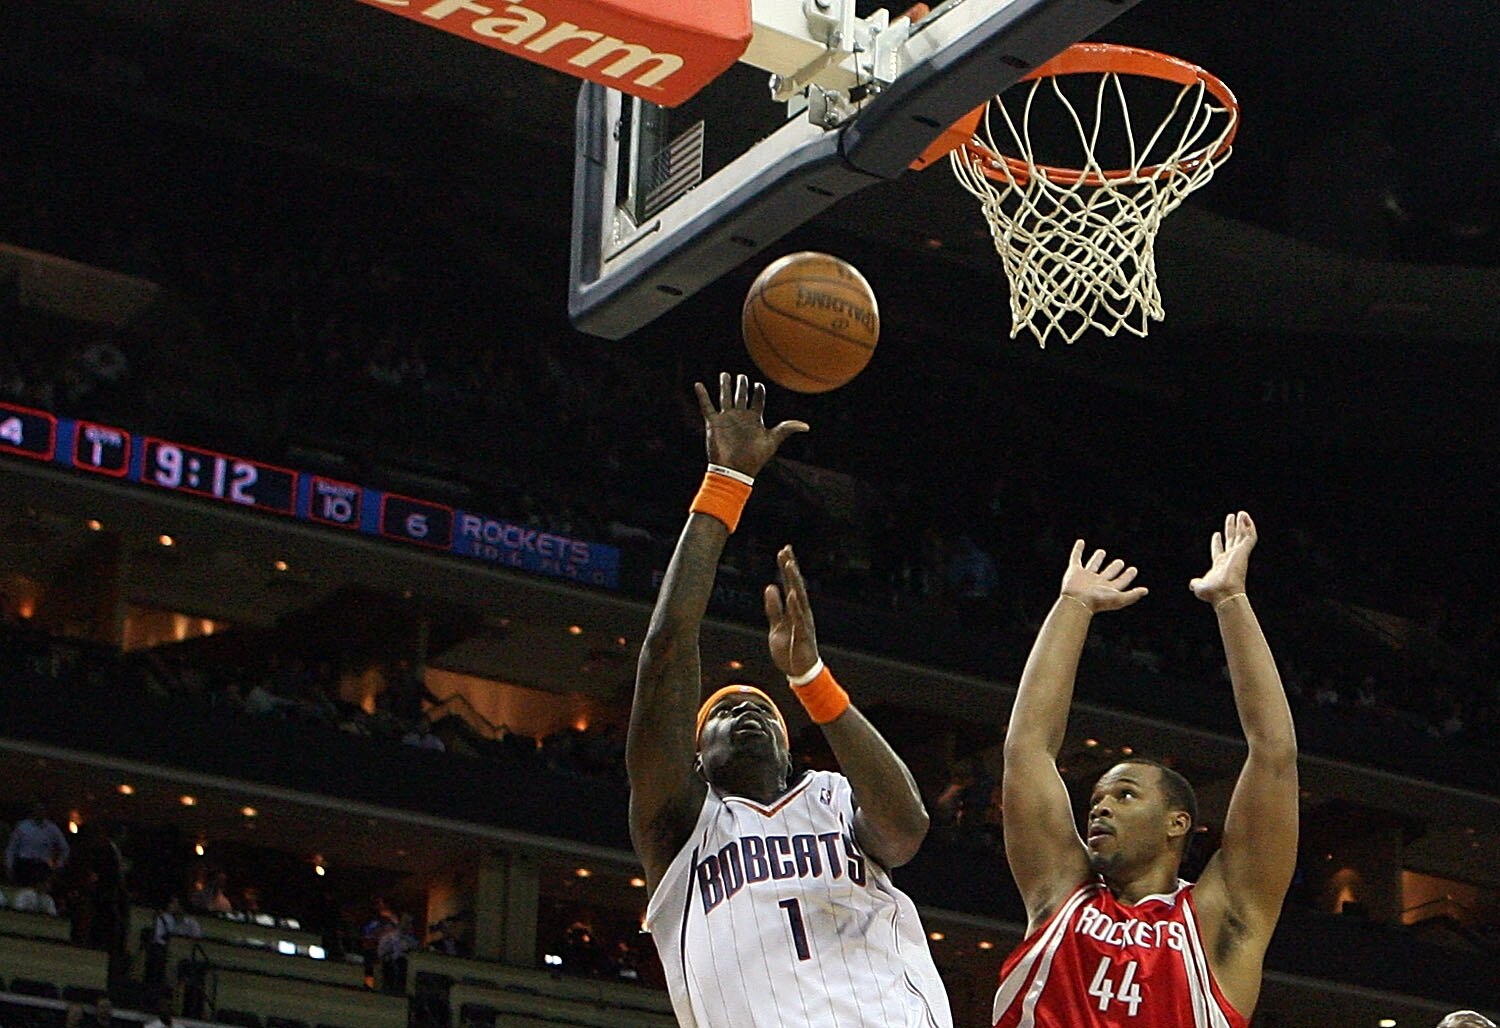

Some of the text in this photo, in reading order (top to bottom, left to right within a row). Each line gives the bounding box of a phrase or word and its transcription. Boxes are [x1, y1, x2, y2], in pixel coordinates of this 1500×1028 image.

[420, 0, 684, 87] Farm
[155, 444, 258, 504] 9:12
[322, 495, 352, 523] 10
[406, 513, 428, 538] 6
[462, 513, 591, 564] ROCKETS
[697, 832, 867, 915] BOBCATS
[778, 897, 811, 961] 1
[1075, 904, 1184, 952] ROCKETS
[1088, 956, 1143, 1017] 44
